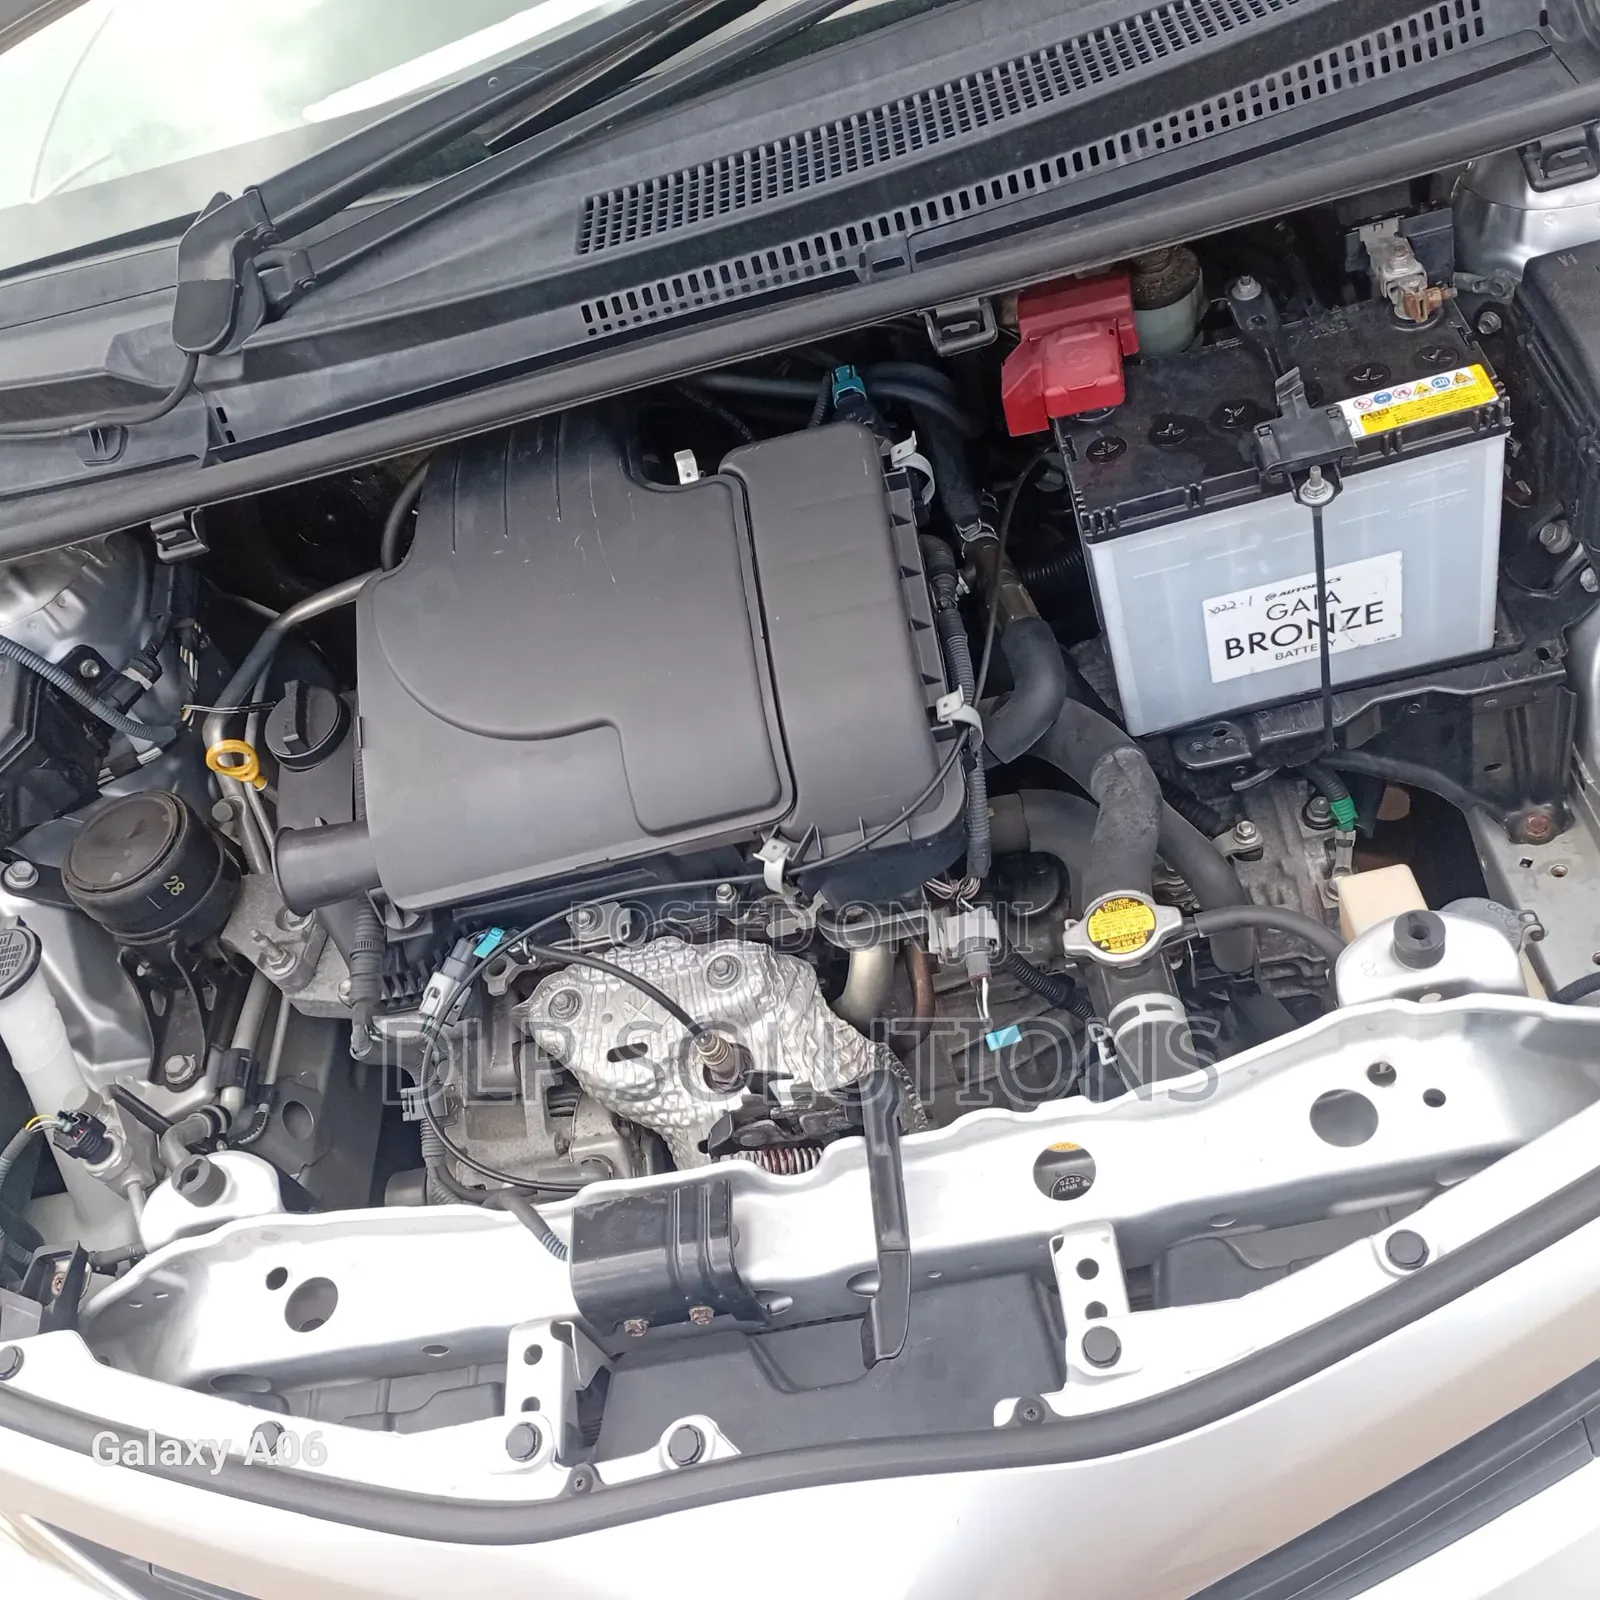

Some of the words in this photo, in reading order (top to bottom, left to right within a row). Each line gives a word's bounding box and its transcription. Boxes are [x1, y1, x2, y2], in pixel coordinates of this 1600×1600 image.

[1266, 589, 1342, 621] GAIA
[1225, 601, 1384, 660] BRONZE
[1275, 638, 1337, 661] BATTEY
[163, 875, 186, 896] 28
[1103, 898, 1130, 908] CAUTION
[1104, 901, 1139, 913] ATTENTION
